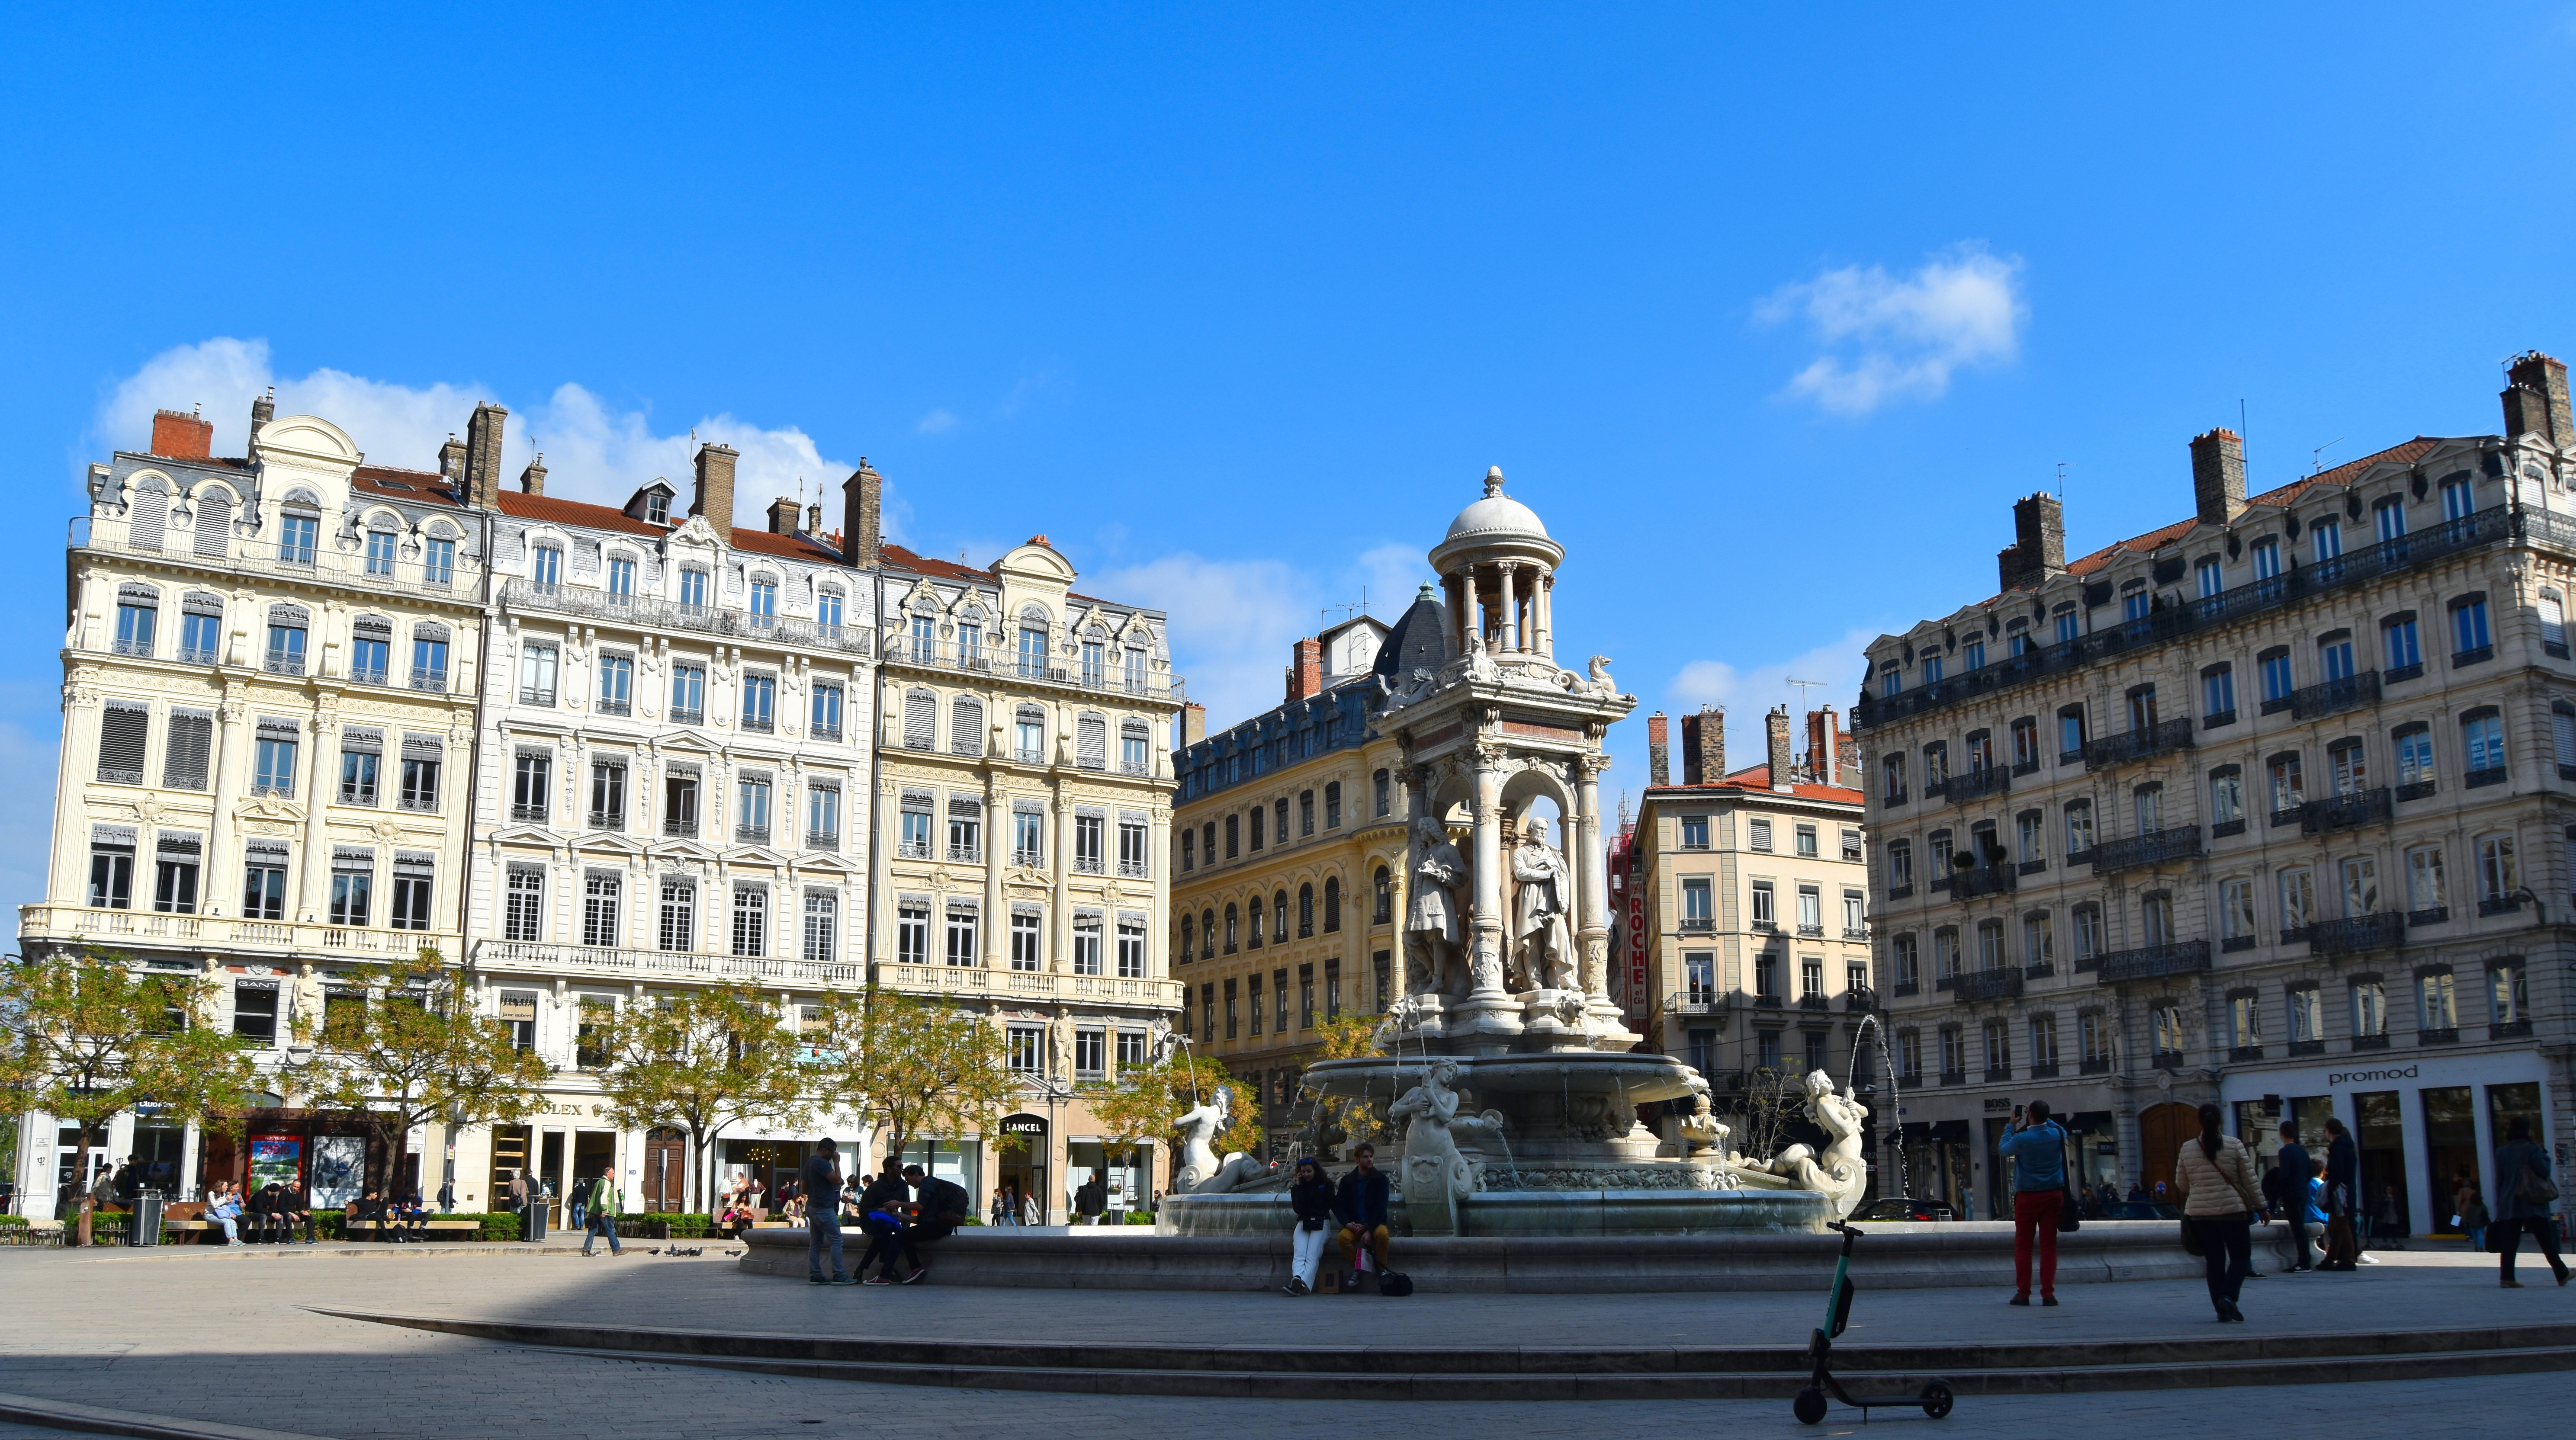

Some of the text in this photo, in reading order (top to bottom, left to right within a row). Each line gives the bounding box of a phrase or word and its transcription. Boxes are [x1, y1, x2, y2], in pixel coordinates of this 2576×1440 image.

[1631, 897, 1644, 985] ROCHE
[2329, 1065, 2418, 1086] promod
[1984, 1097, 2011, 1108] BOSS
[533, 1104, 582, 1116] OLEX
[1006, 1123, 1041, 1132] LANCEL
